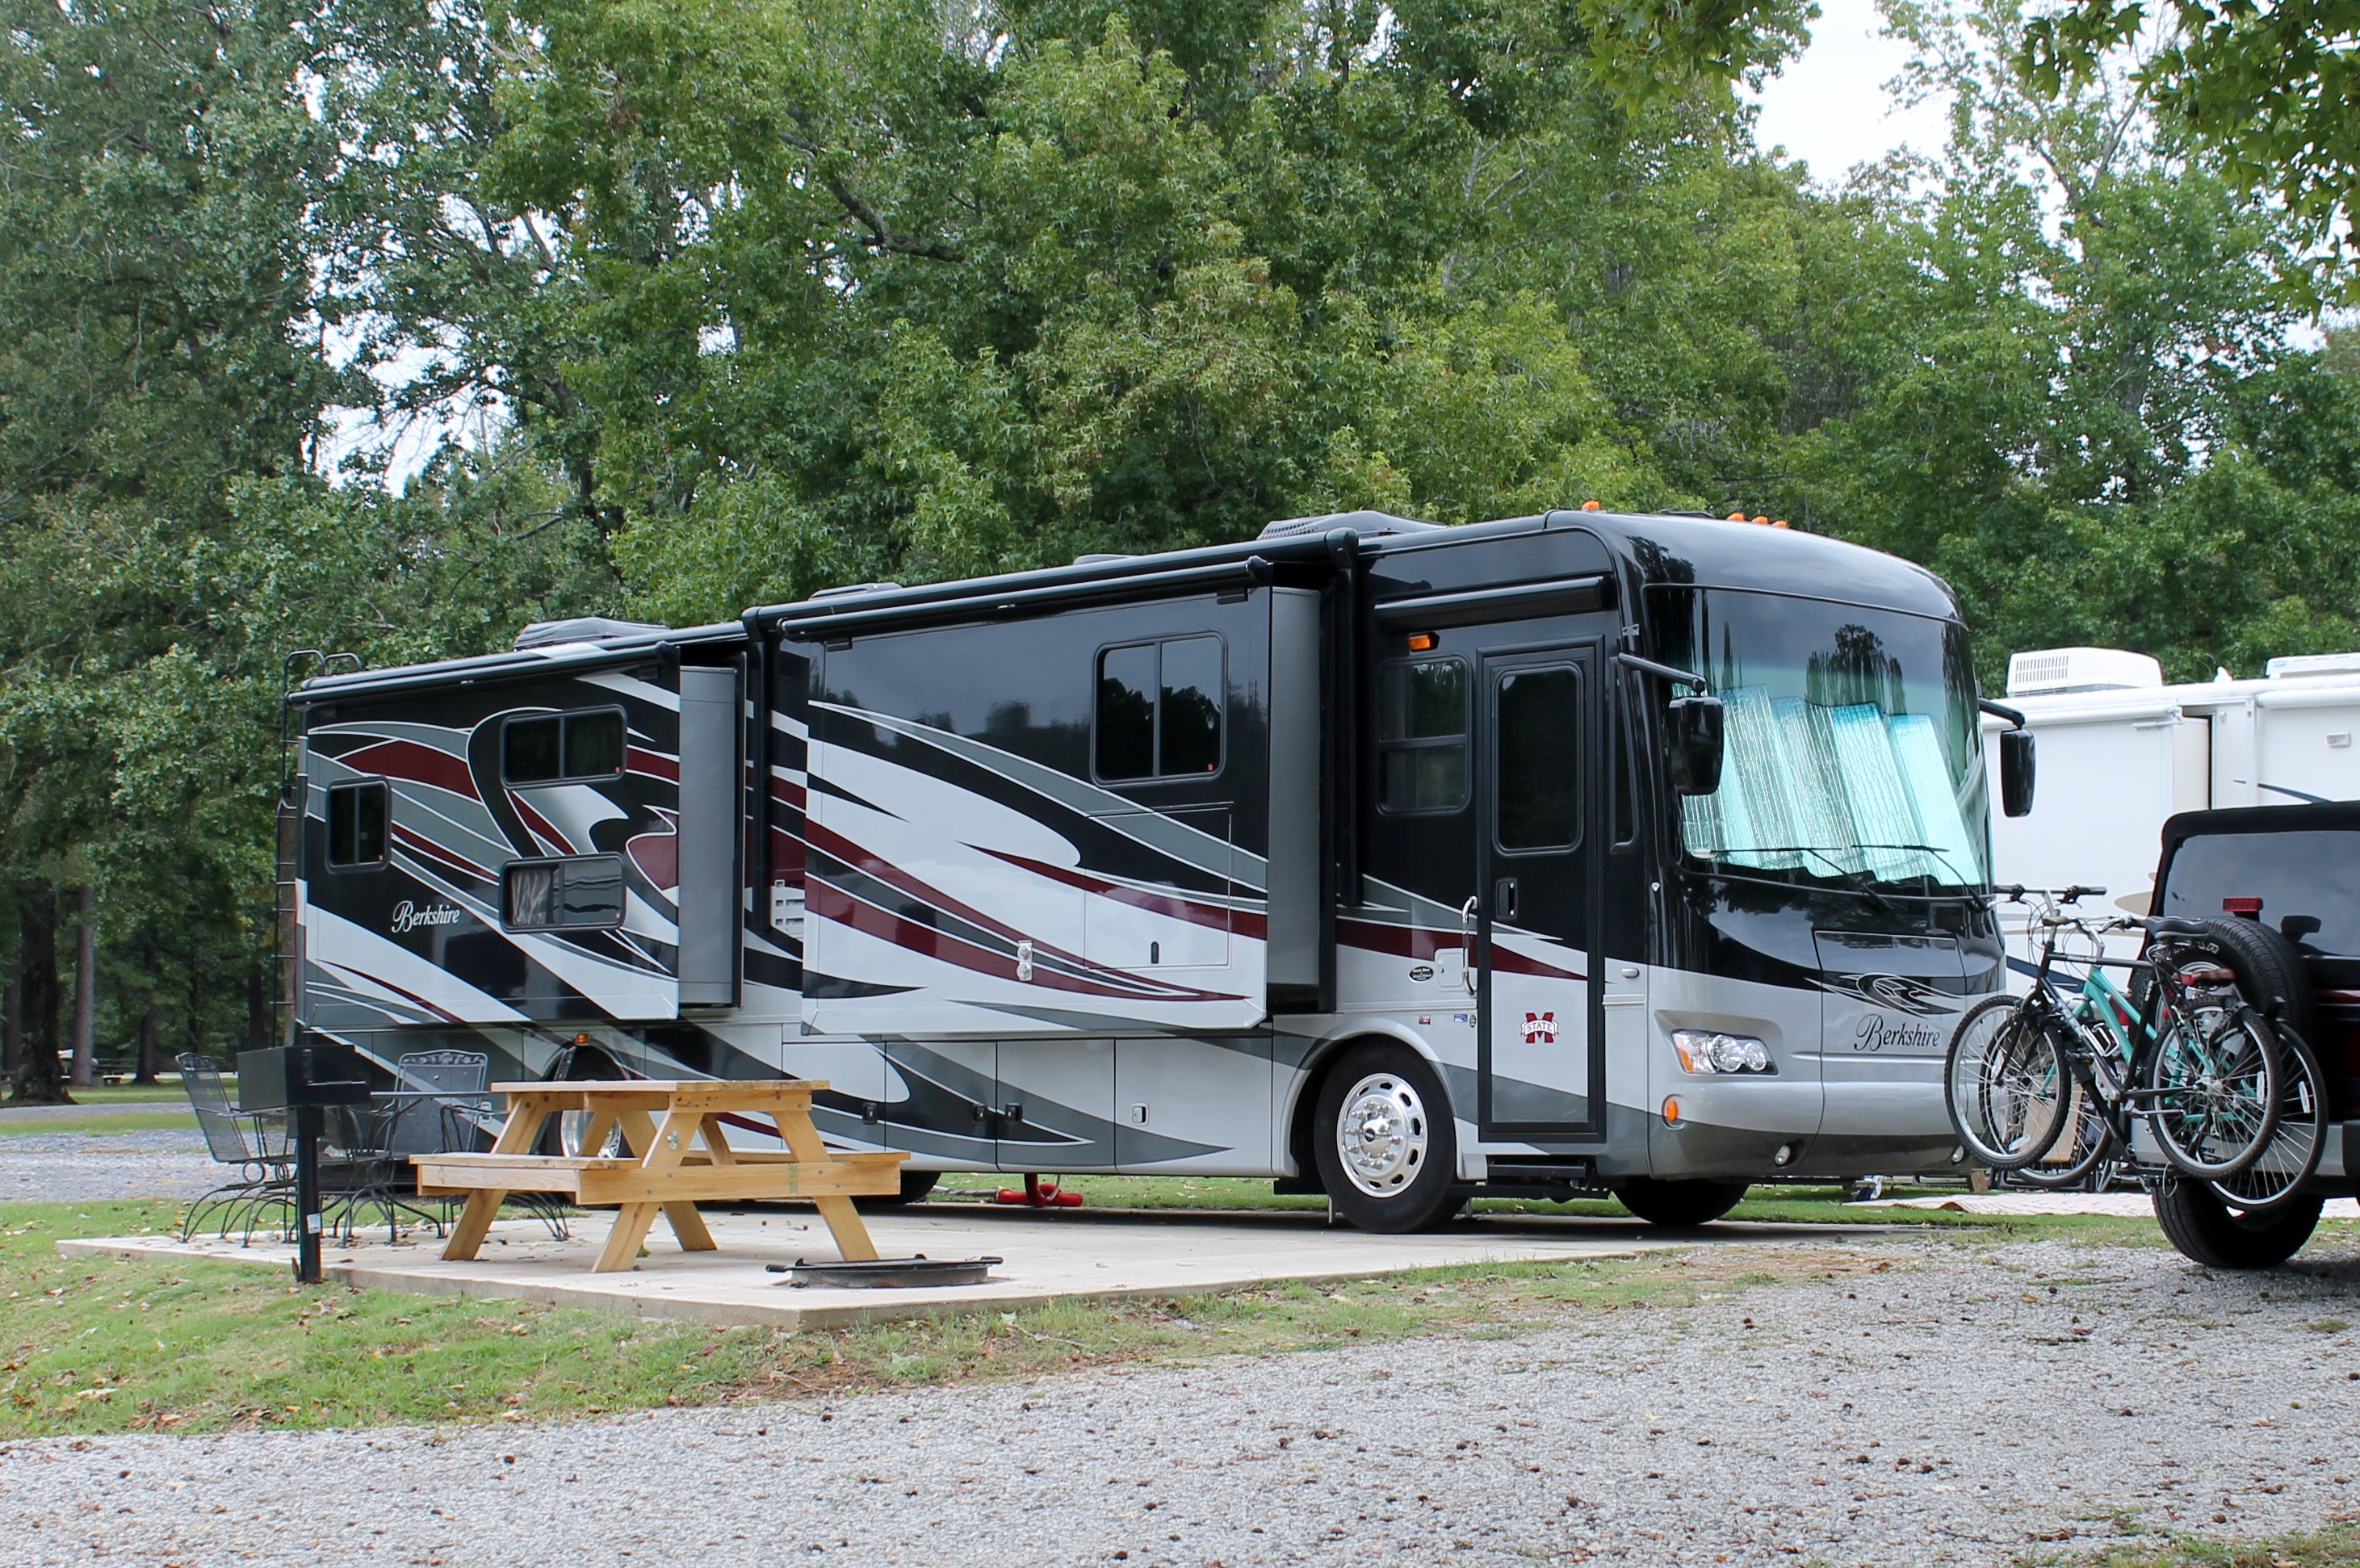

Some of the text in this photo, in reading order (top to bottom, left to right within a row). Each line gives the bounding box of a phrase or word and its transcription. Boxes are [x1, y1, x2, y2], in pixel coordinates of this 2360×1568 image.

[391, 899, 460, 933] Berkshire
[1527, 1021, 1553, 1033] STATE
[1854, 1013, 1940, 1052] Berkshire
